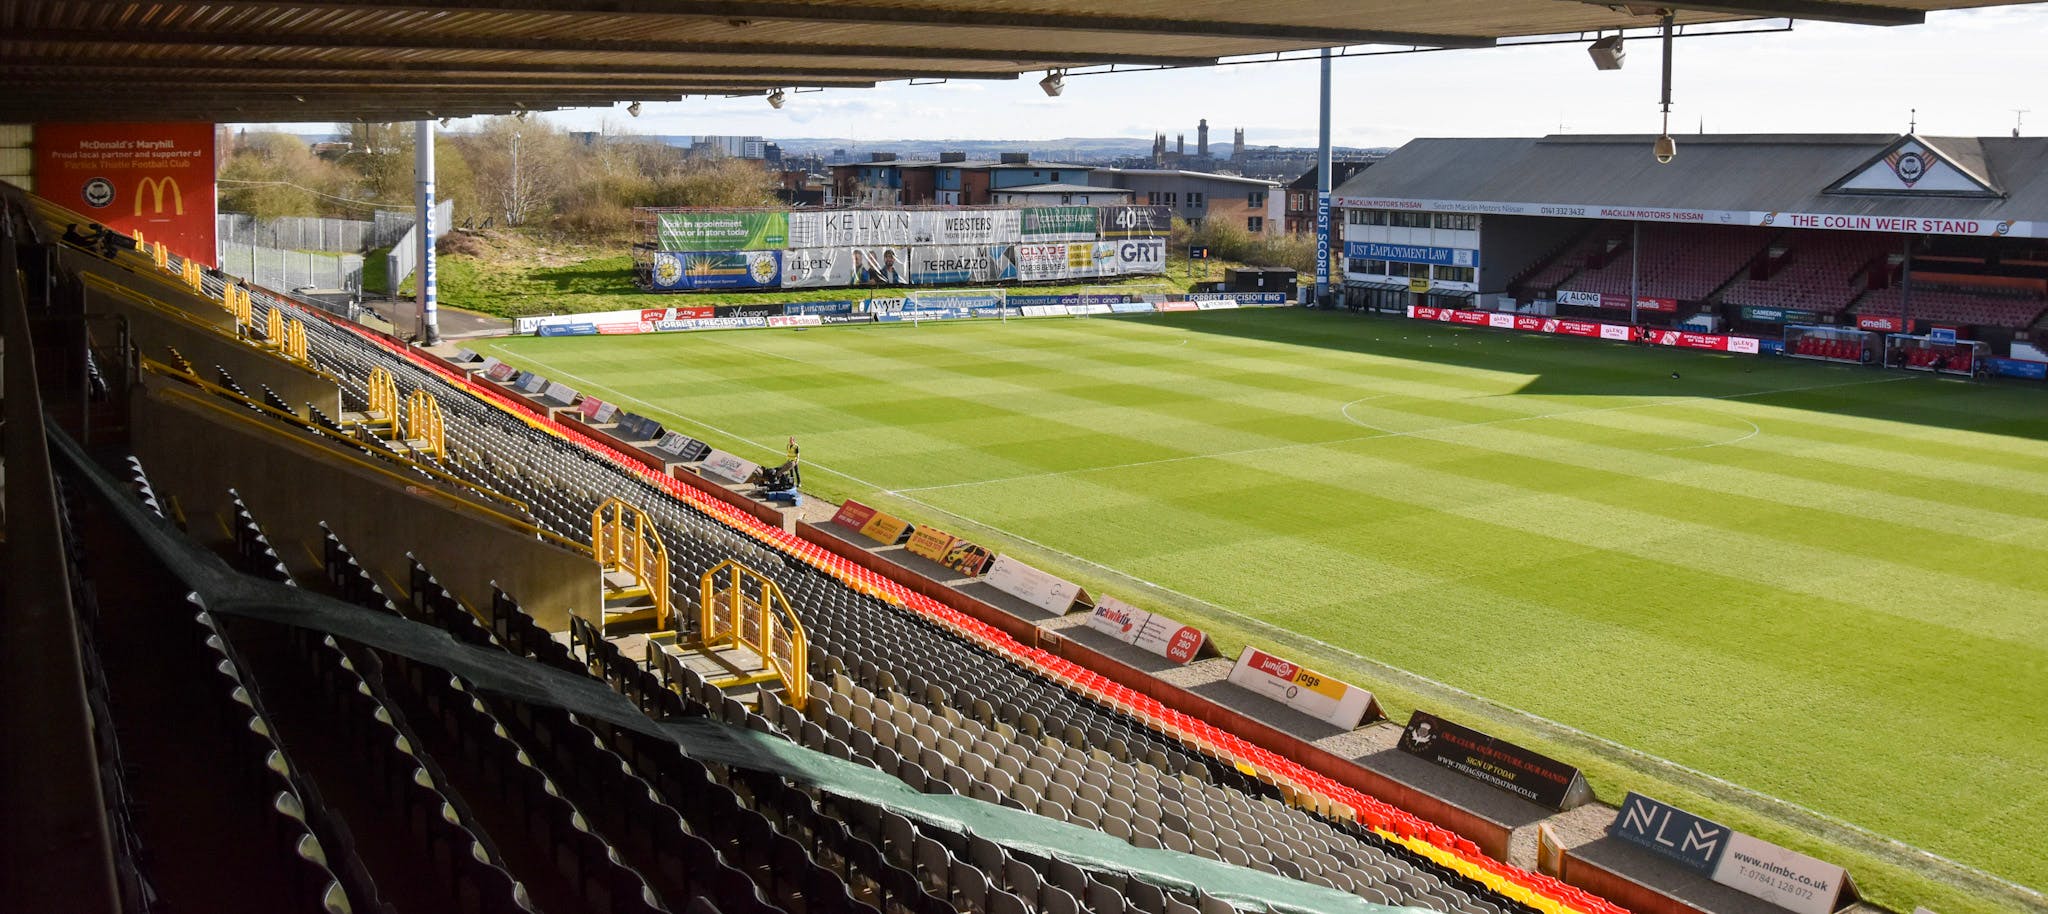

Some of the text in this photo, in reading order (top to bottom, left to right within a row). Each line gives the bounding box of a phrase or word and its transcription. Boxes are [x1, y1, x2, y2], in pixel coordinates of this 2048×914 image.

[80, 140, 174, 150] McDonald's Maryhill
[102, 151, 133, 160] partner
[152, 151, 191, 160] supporter
[64, 161, 97, 169] Partick
[132, 160, 169, 168] Football
[170, 159, 191, 168] Club
[1455, 203, 1478, 211] Macklin
[1116, 210, 1137, 229] 40
[1600, 209, 1704, 220] MACKLIN MOTORS NISSAN
[695, 220, 742, 229] appointment
[826, 214, 909, 230] KELVIN
[945, 217, 992, 231] WEBSTERS
[1790, 215, 1979, 233] THE COLIN WEIR STAND
[727, 229, 749, 237] today
[1317, 200, 1329, 276] JUST SCORE
[1021, 245, 1066, 255] CLYDE
[1120, 243, 1163, 263] GRT
[1349, 242, 1368, 257] JUST
[1370, 243, 1428, 259] EMPLOYMENT
[1429, 247, 1448, 260] LAW
[791, 256, 832, 276] tigers
[1061, 296, 1079, 304] cinch
[1103, 296, 1119, 304] cinch
[1223, 294, 1262, 302] PRECISION
[1570, 292, 1599, 301] ALONG
[1418, 308, 1435, 316] GLEN'S
[1752, 309, 1782, 317] CAMERON
[770, 316, 798, 326] PTS
[1518, 318, 1539, 326] GLEN'S
[1861, 319, 1892, 329] oneills
[1733, 340, 1754, 348] GLEN'S
[1261, 658, 1293, 677] junior
[1296, 669, 1320, 687] jags
[1441, 731, 1456, 744] OUR
[1477, 744, 1493, 757] OUR
[1524, 762, 1540, 775] OUR
[1541, 768, 1568, 785] HANDS
[1466, 756, 1517, 782] SIGN UP TODAY
[1622, 799, 1720, 861] NLM
[1733, 850, 1829, 893] www.nlmbc.co.uk
[1748, 868, 1776, 886] 07841
[1777, 879, 1794, 895] 128
[1795, 885, 1814, 900] 072
